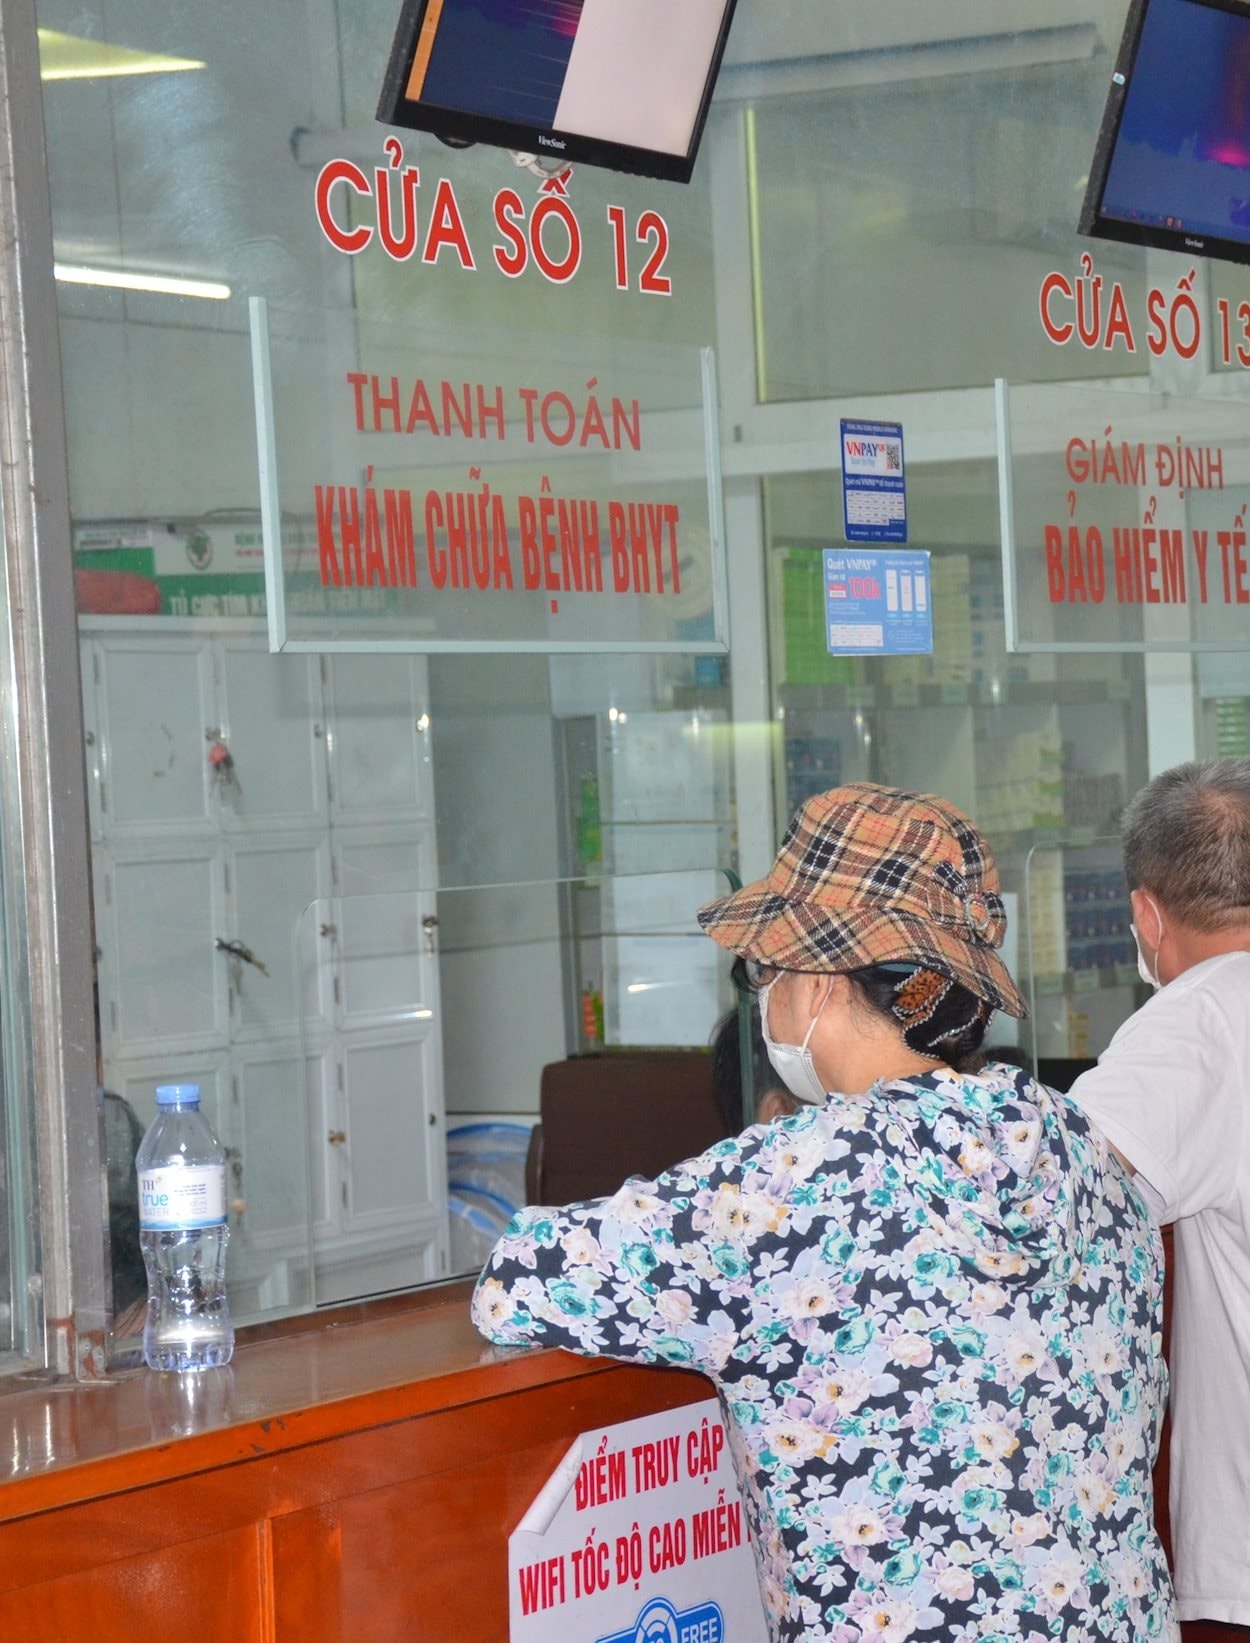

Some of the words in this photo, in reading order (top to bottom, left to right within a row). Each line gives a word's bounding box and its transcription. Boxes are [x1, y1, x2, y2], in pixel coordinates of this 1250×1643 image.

[315, 135, 476, 270] CỬA
[492, 168, 582, 284] SỐ
[607, 204, 672, 296] 12
[1039, 252, 1136, 353] CỬA
[1147, 266, 1200, 361] SỐ
[347, 372, 505, 441] THANH
[519, 377, 641, 451] TOÁN
[1066, 425, 1147, 486] GIÁM
[1155, 436, 1224, 499] ĐỊNH
[315, 465, 417, 588] KHÁM
[425, 467, 514, 591] CHỮA
[518, 476, 603, 614] BỆNH
[608, 501, 681, 594] BHYT
[1045, 490, 1105, 604] BẢO
[1112, 495, 1186, 603] HIỂM
[1192, 531, 1208, 603] Y
[1217, 504, 1250, 603] TẾ
[142, 1193, 168, 1206] true
[143, 1180, 154, 1191] TH
[575, 1435, 627, 1511] ĐIỂM
[632, 1435, 680, 1493] TRUY
[687, 1417, 724, 1485] CẬP
[519, 1555, 566, 1616] WIFI
[571, 1528, 609, 1599] TỐC
[616, 1522, 643, 1591] ĐỘ
[649, 1518, 686, 1574] CAO
[692, 1488, 741, 1560] MIỄN
[681, 1617, 718, 1643] FREE
